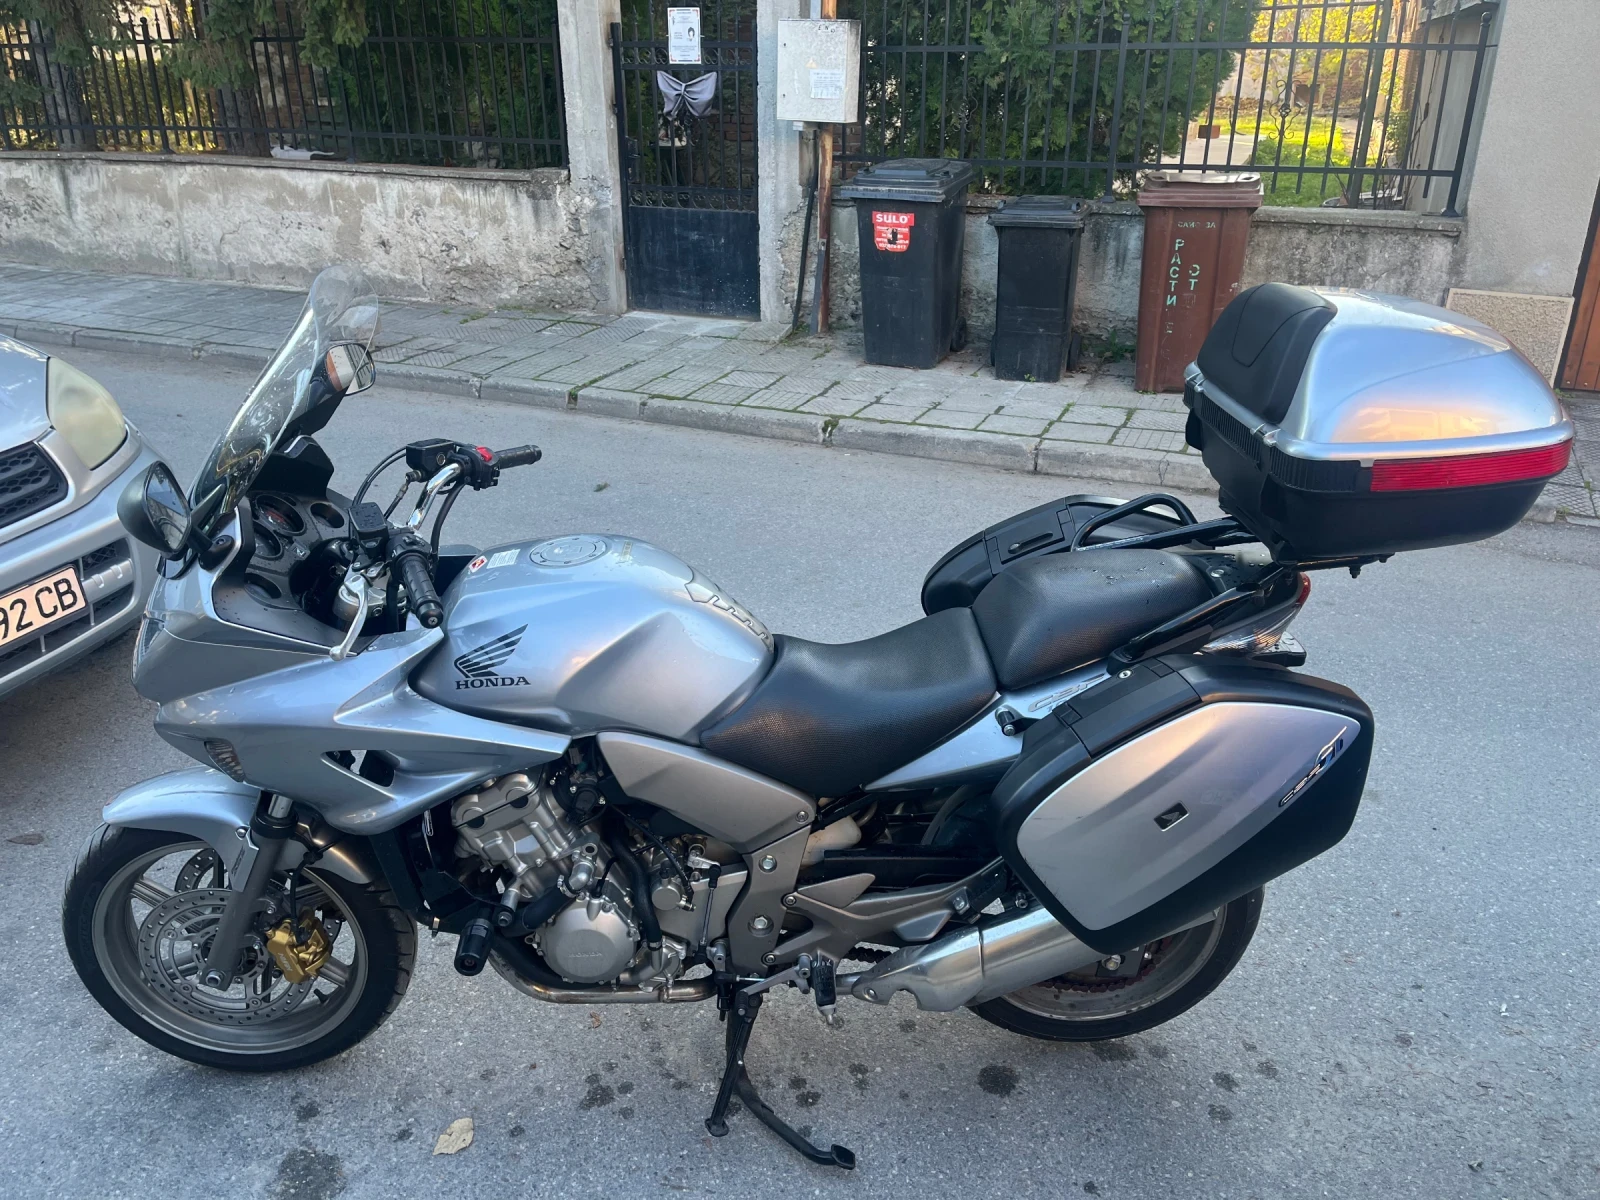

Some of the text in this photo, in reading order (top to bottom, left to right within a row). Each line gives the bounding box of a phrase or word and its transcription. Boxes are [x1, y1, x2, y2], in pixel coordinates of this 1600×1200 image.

[876, 213, 909, 224] SULO
[35, 577, 78, 619] CB
[455, 676, 532, 690] HONDA
